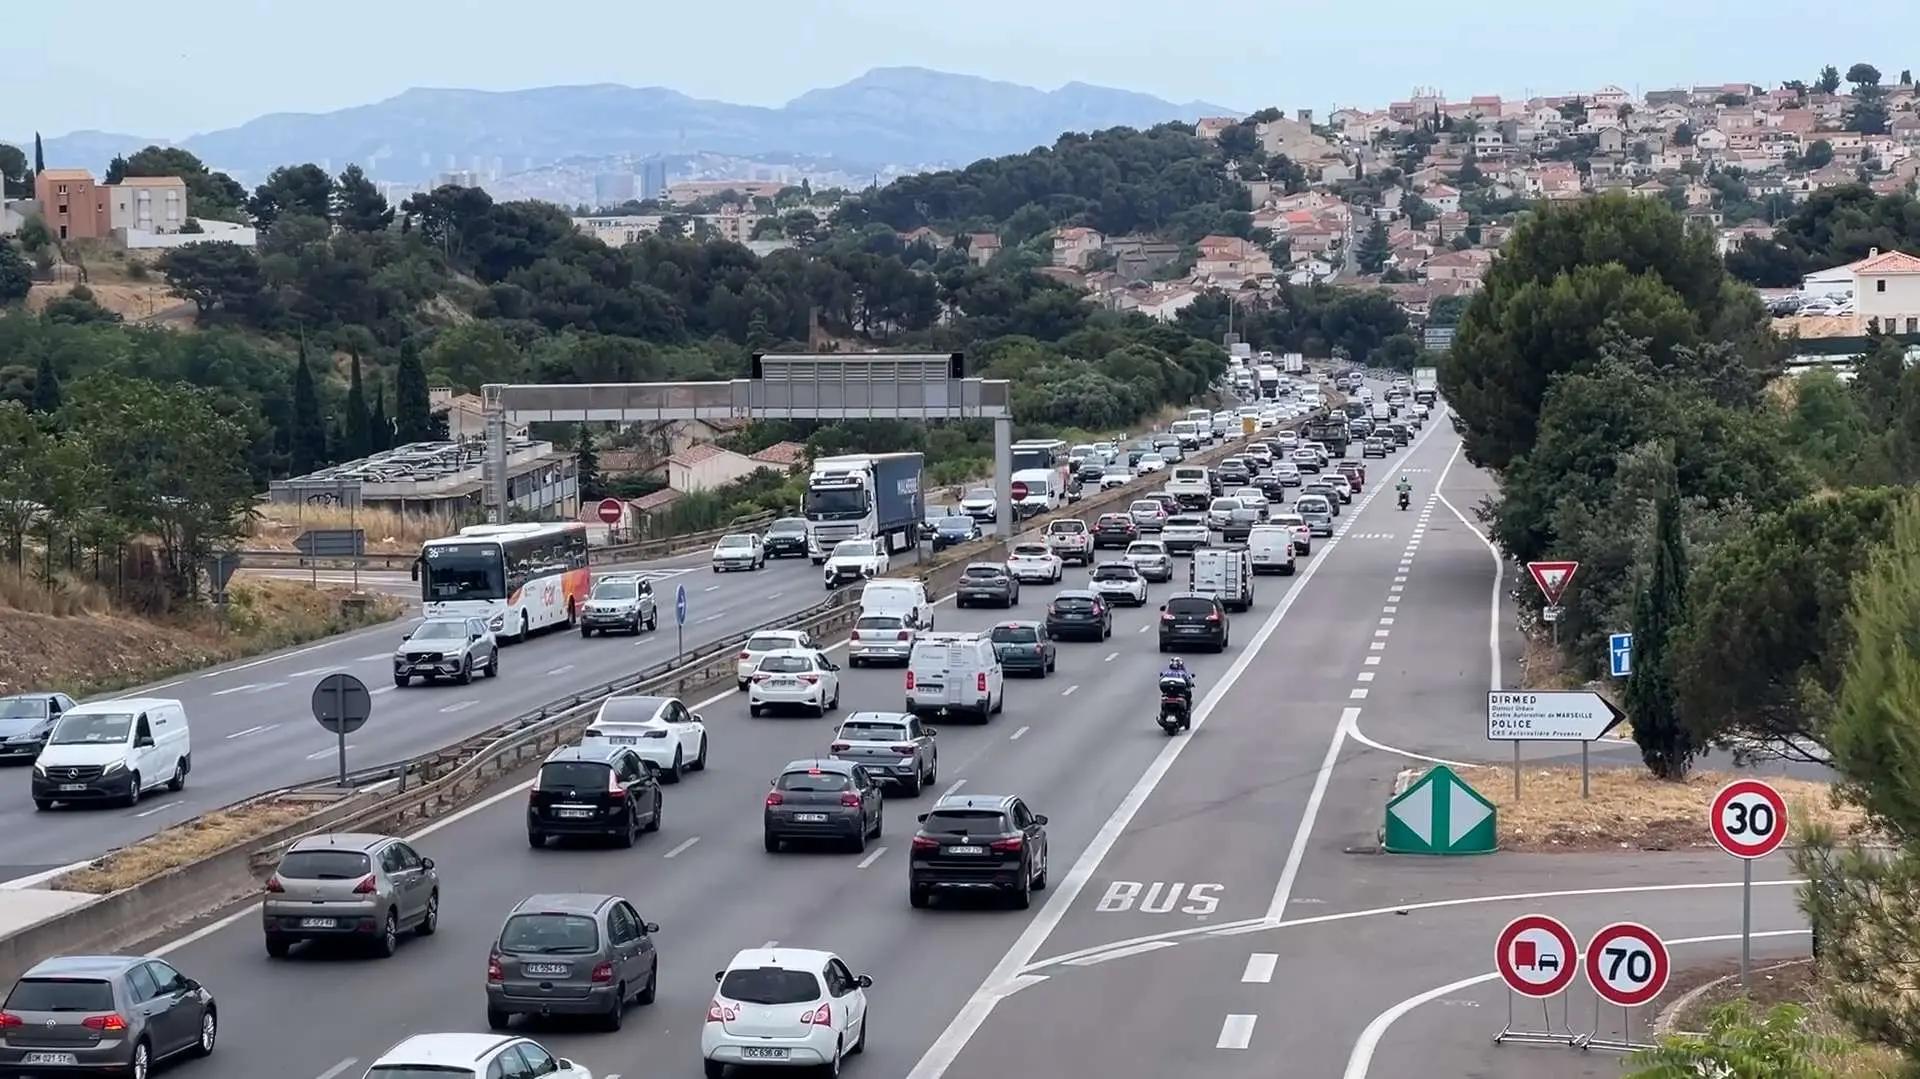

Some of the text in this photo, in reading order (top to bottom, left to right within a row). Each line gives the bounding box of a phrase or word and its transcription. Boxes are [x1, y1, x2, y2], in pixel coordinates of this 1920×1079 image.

[1491, 696, 1537, 704] DIRMED
[1491, 720, 1532, 728] POLICE
[1726, 802, 1774, 835] 30
[1095, 881, 1225, 914] BUS
[1605, 947, 1652, 983] 70
